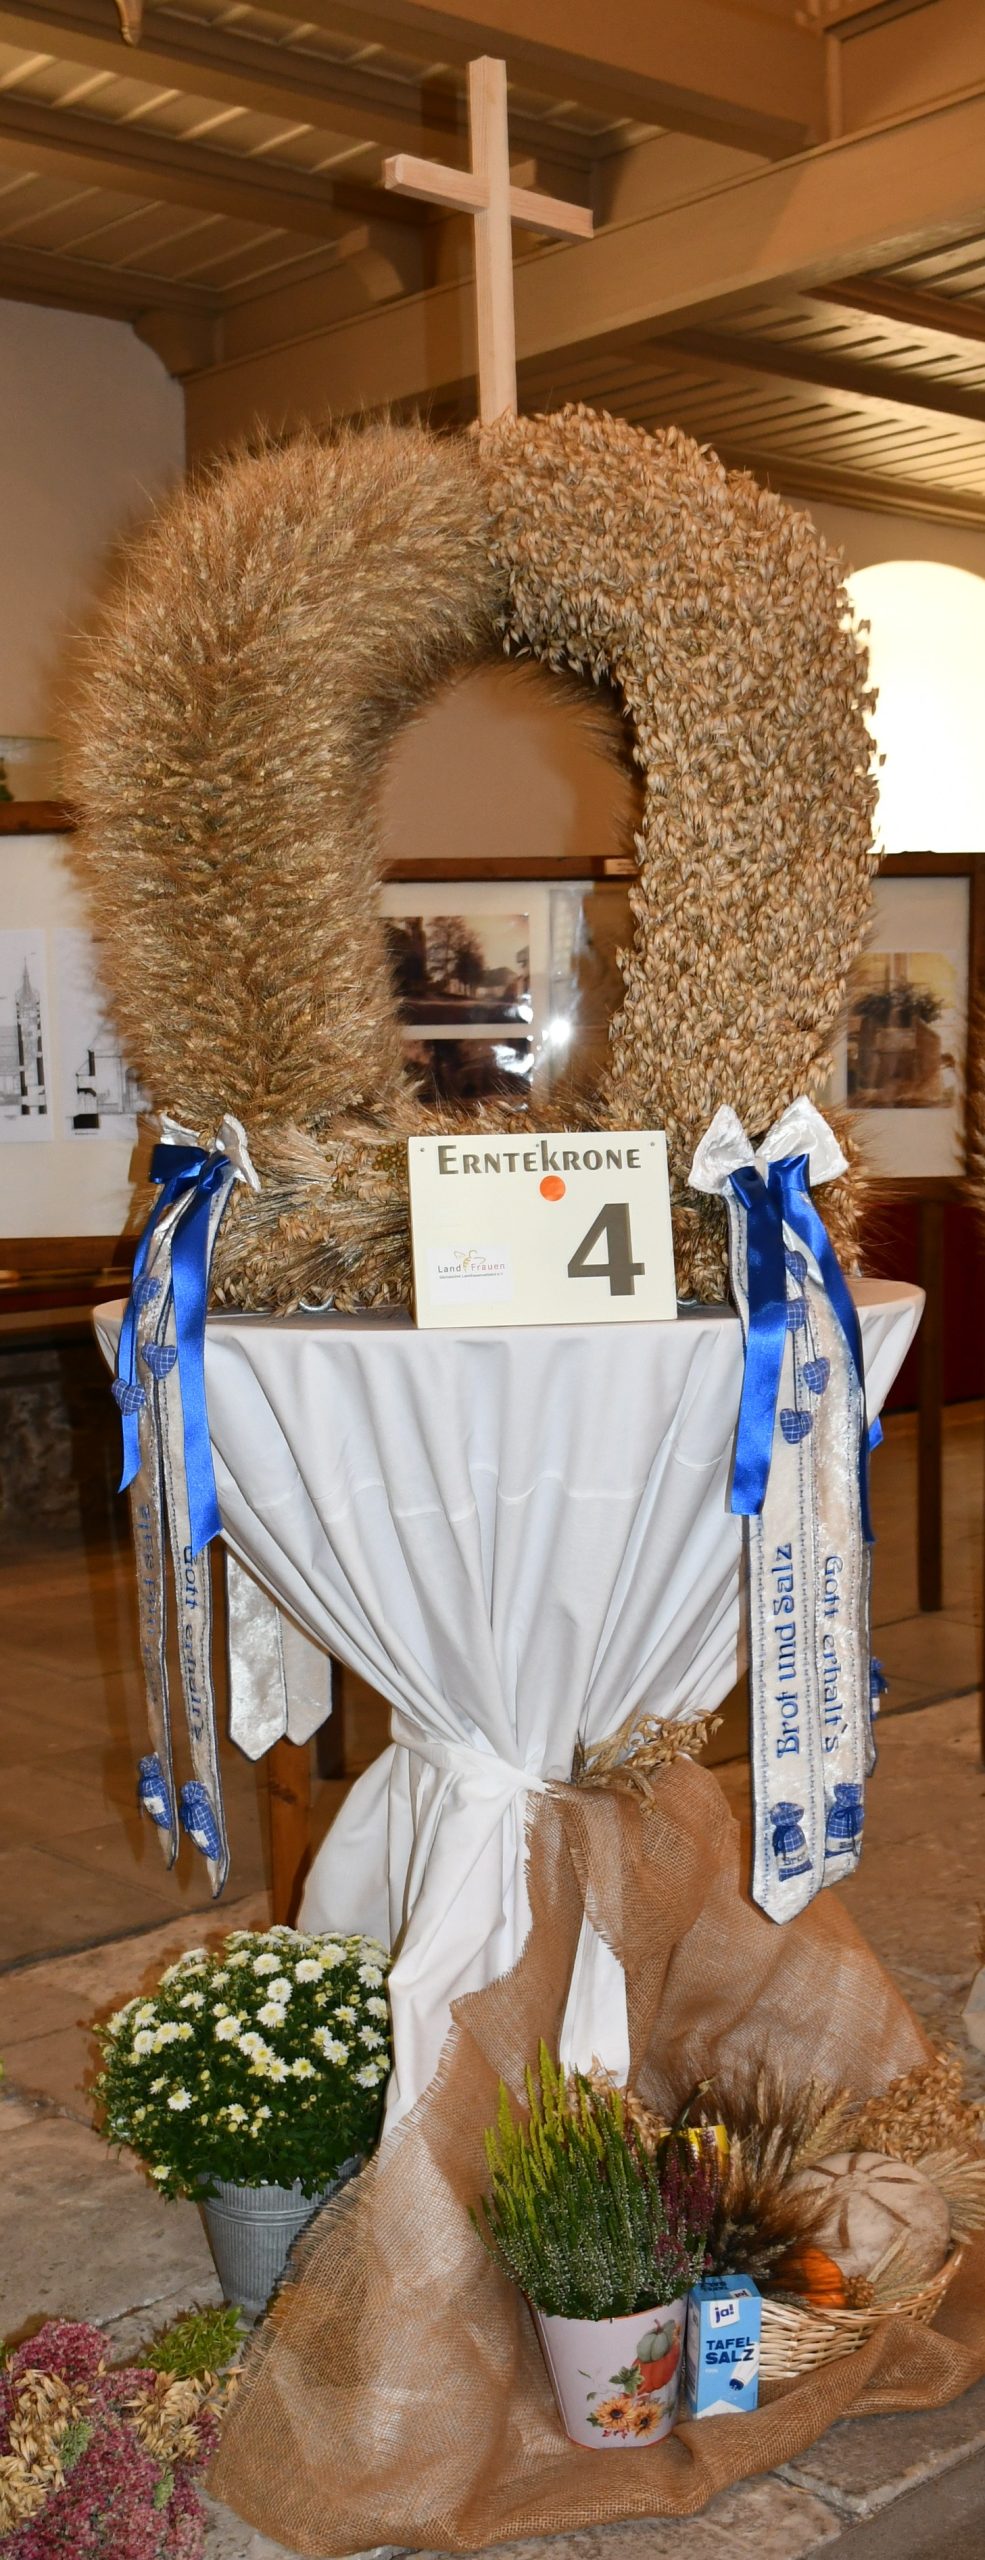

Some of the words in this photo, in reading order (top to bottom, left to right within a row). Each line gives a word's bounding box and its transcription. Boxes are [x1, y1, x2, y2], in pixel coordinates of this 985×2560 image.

[437, 1264, 462, 1273] Land
[470, 1263, 506, 1271] Frauen
[567, 1202, 645, 1296] 4
[771, 1542, 795, 1616] Salz
[822, 1556, 843, 1618] Gott
[774, 1621, 797, 1682] und
[775, 1691, 800, 1759] Brot
[706, 2336, 755, 2351] TAFEL
[714, 2303, 734, 2323] ja!
[705, 2348, 754, 2365] SALZ
